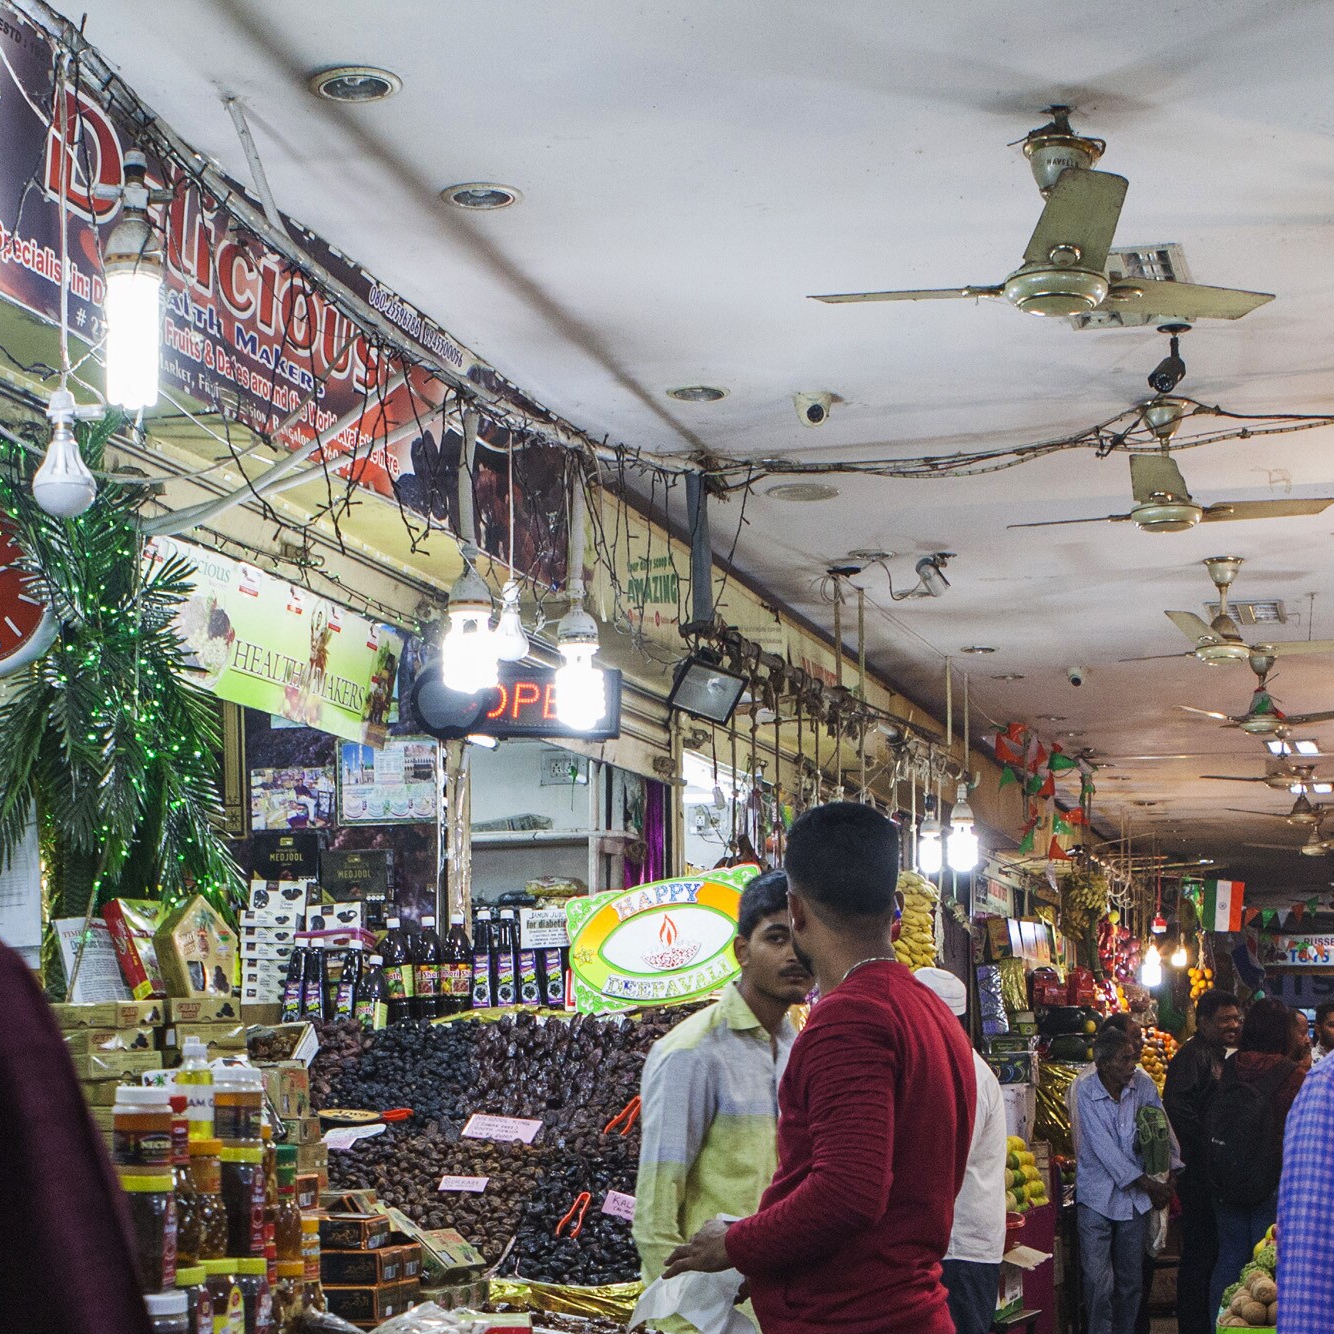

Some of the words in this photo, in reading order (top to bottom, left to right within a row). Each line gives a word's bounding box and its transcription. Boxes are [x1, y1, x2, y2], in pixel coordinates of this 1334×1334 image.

[627, 573, 678, 603] AMAZING
[232, 639, 305, 687] HEALTH
[312, 667, 365, 711] MAKERS
[487, 681, 557, 719] OPE
[269, 853, 304, 862] MEDJOOL
[614, 882, 703, 920] HAPPY
[607, 959, 733, 999] DEEPAVALI
